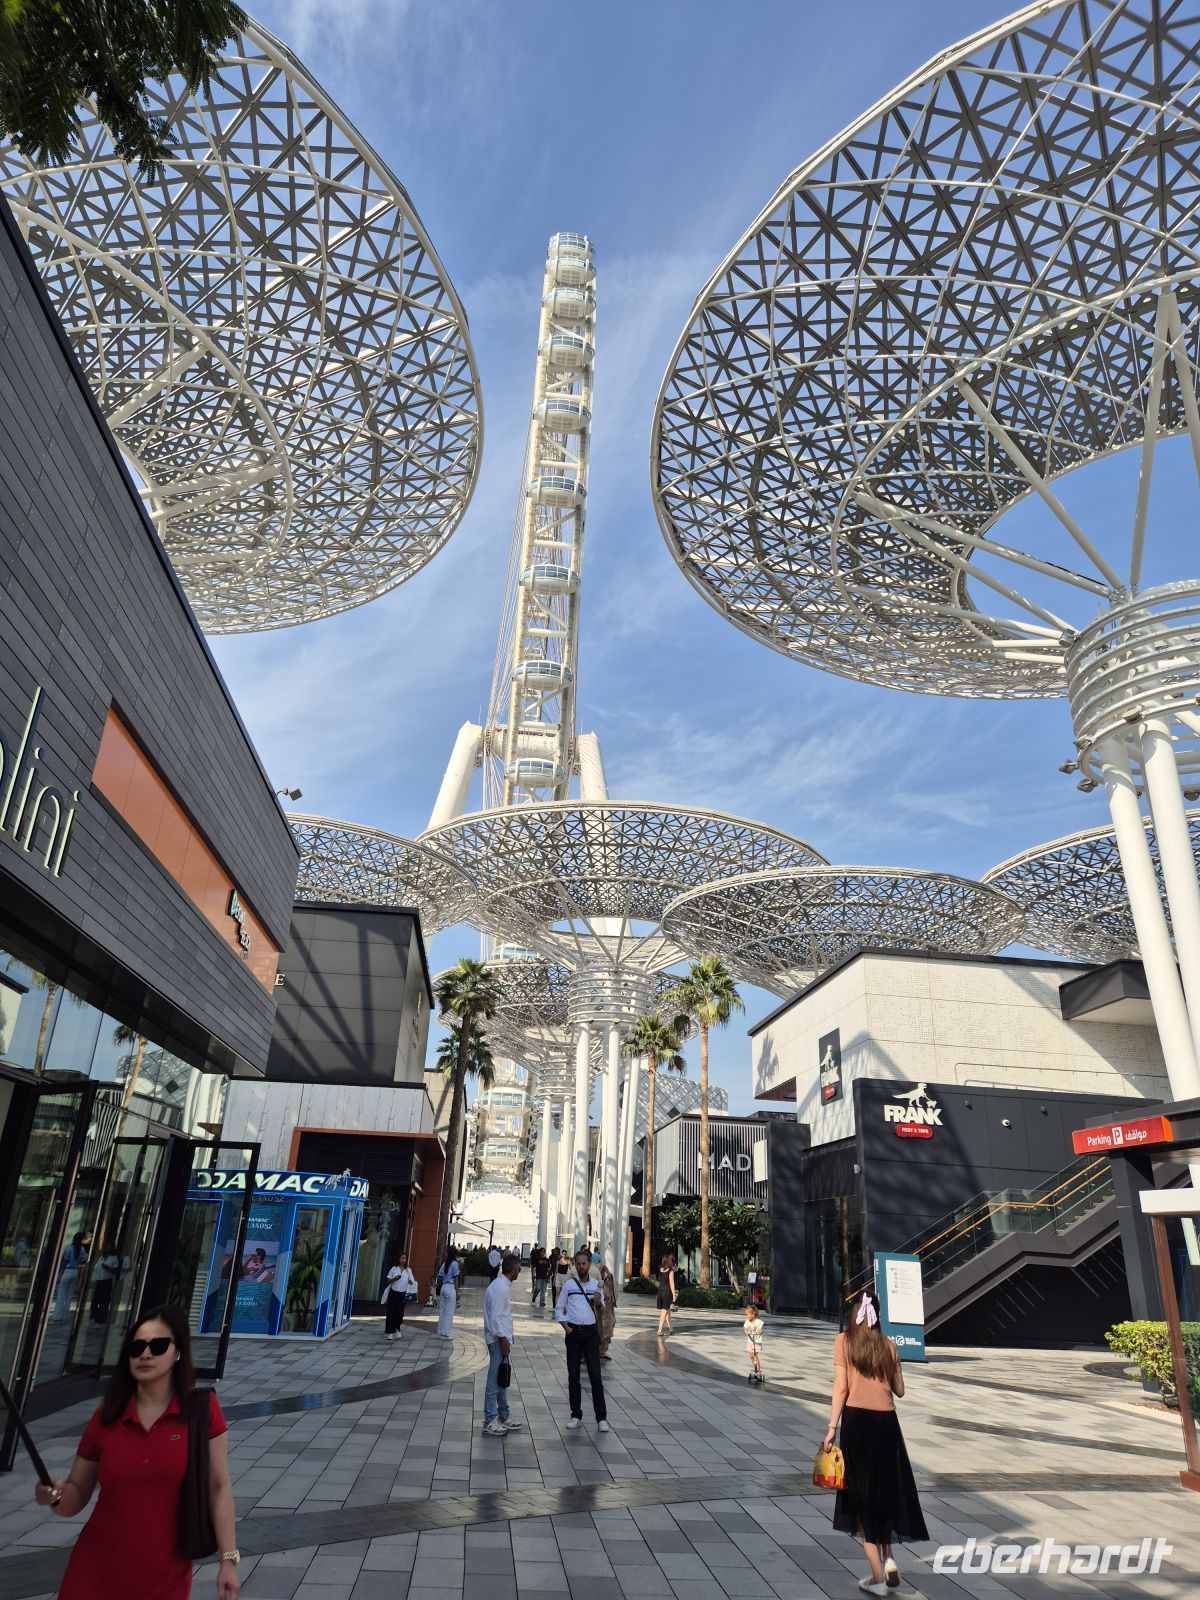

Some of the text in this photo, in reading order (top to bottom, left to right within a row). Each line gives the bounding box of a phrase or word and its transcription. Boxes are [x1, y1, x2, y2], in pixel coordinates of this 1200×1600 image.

[0, 686, 81, 877] lini
[883, 1104, 943, 1126] FRANK
[1087, 1135, 1112, 1147] Parking
[1125, 1129, 1147, 1141] مواقف
[696, 1151, 752, 1172] MAD
[349, 1180, 370, 1199] DA
